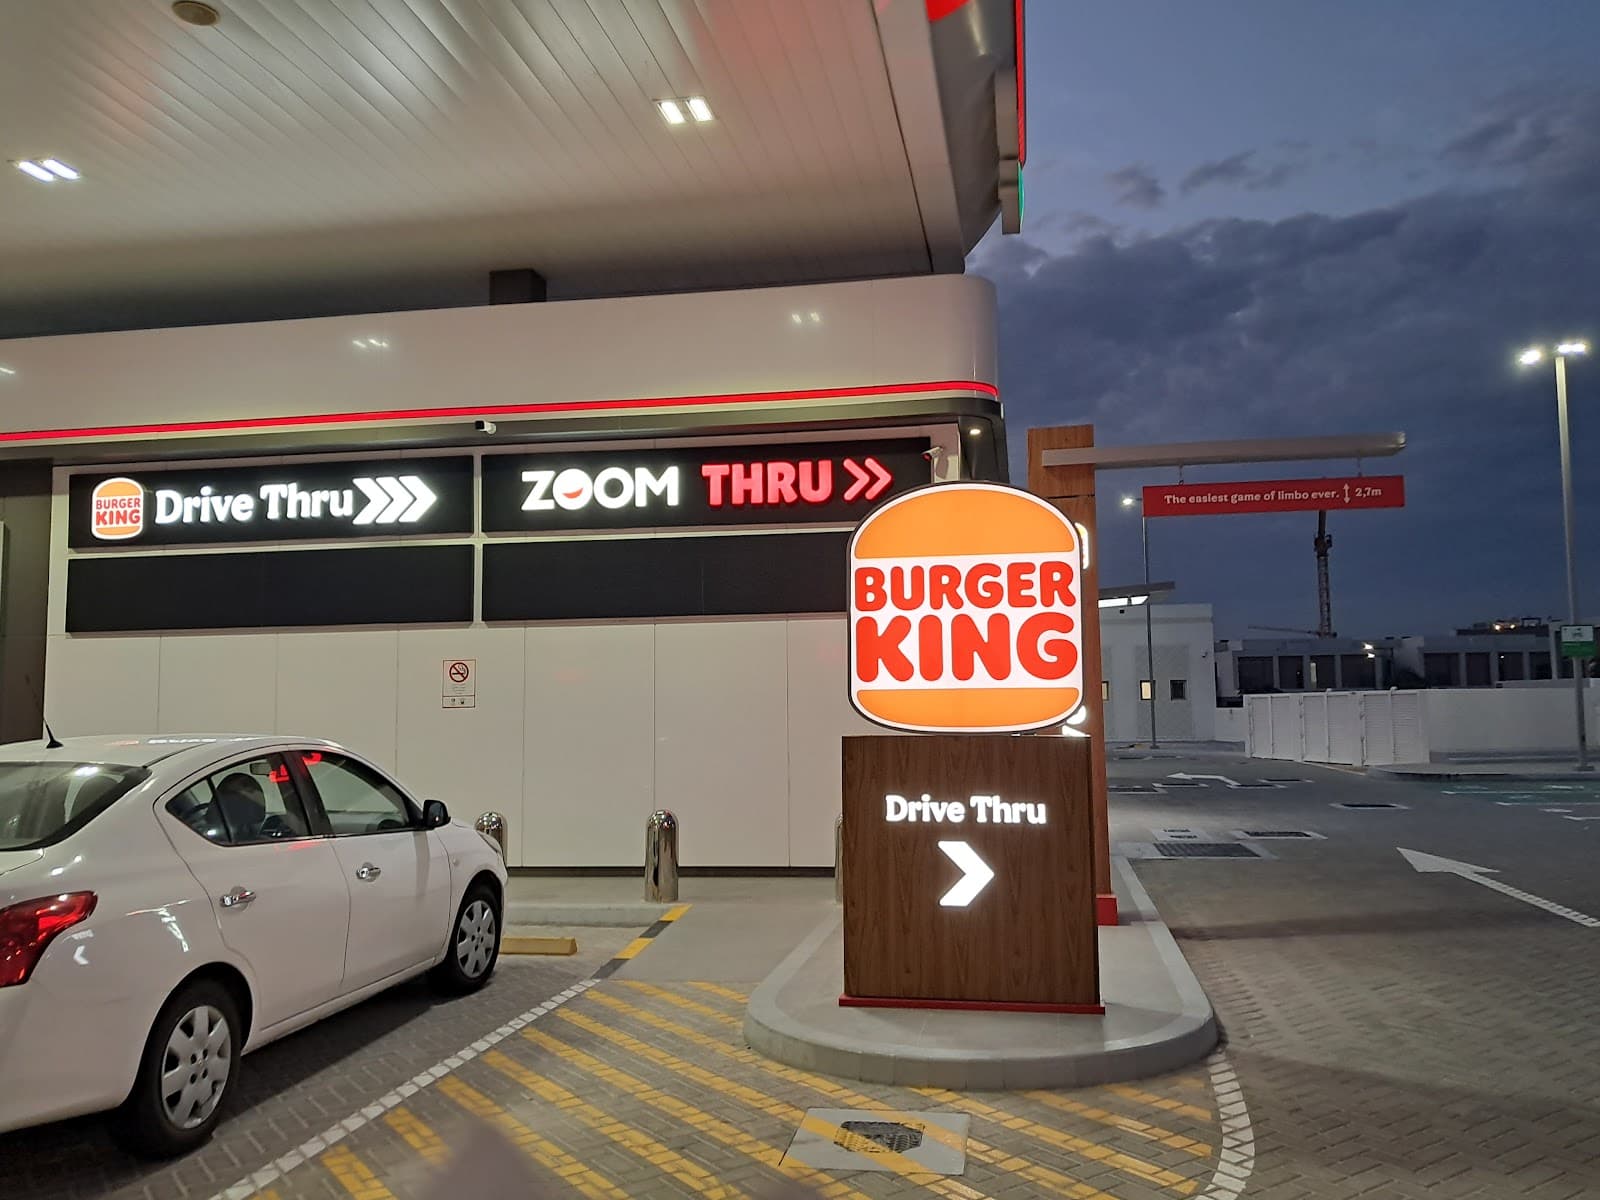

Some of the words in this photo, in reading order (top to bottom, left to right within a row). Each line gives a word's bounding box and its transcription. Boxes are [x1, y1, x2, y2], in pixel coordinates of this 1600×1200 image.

[520, 466, 680, 511] ZOOM
[701, 459, 833, 506] THRU
[1164, 494, 1187, 504] The
[1189, 493, 1229, 503] easiest
[1231, 493, 1261, 504] game
[1263, 490, 1276, 500] of
[1277, 490, 1310, 500] limbo
[1311, 490, 1340, 499] ever.
[96, 498, 141, 510] BURGER
[96, 509, 141, 526] KING
[154, 486, 254, 524] Drive
[259, 483, 353, 520] Thru
[855, 561, 1077, 612] BURGER
[856, 612, 1078, 683] KING
[885, 793, 966, 823] Drive
[969, 795, 1047, 824] Thru
